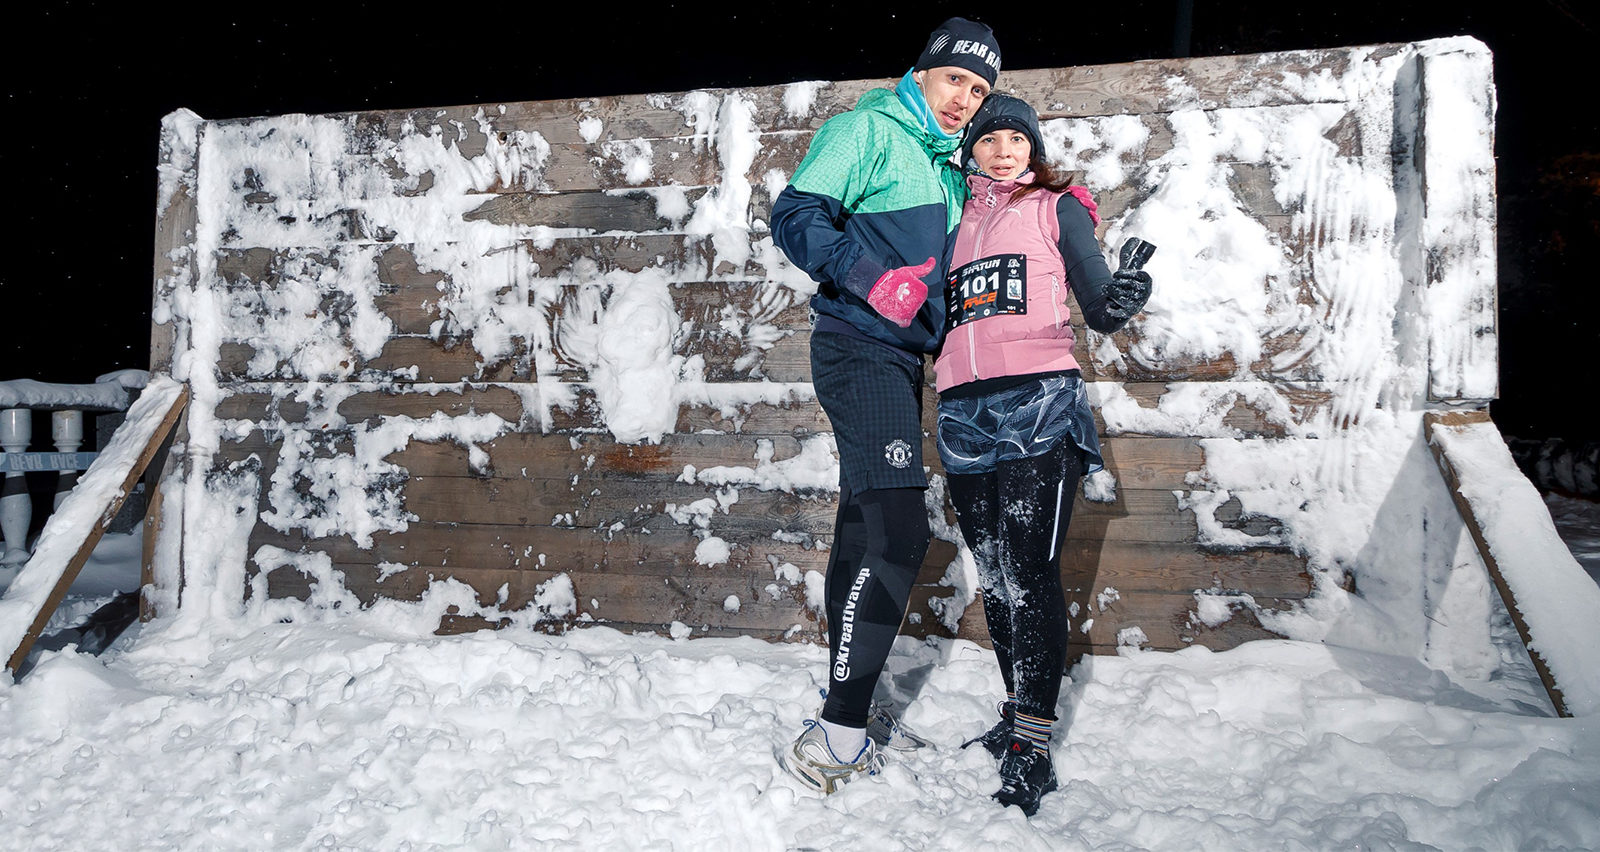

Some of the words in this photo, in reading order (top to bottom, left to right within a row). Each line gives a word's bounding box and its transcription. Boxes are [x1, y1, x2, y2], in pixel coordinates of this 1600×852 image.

[952, 39, 988, 58] BEAR
[962, 259, 1001, 277] SHATUN
[960, 271, 999, 299] 101
[833, 567, 870, 682] @kreativatop
